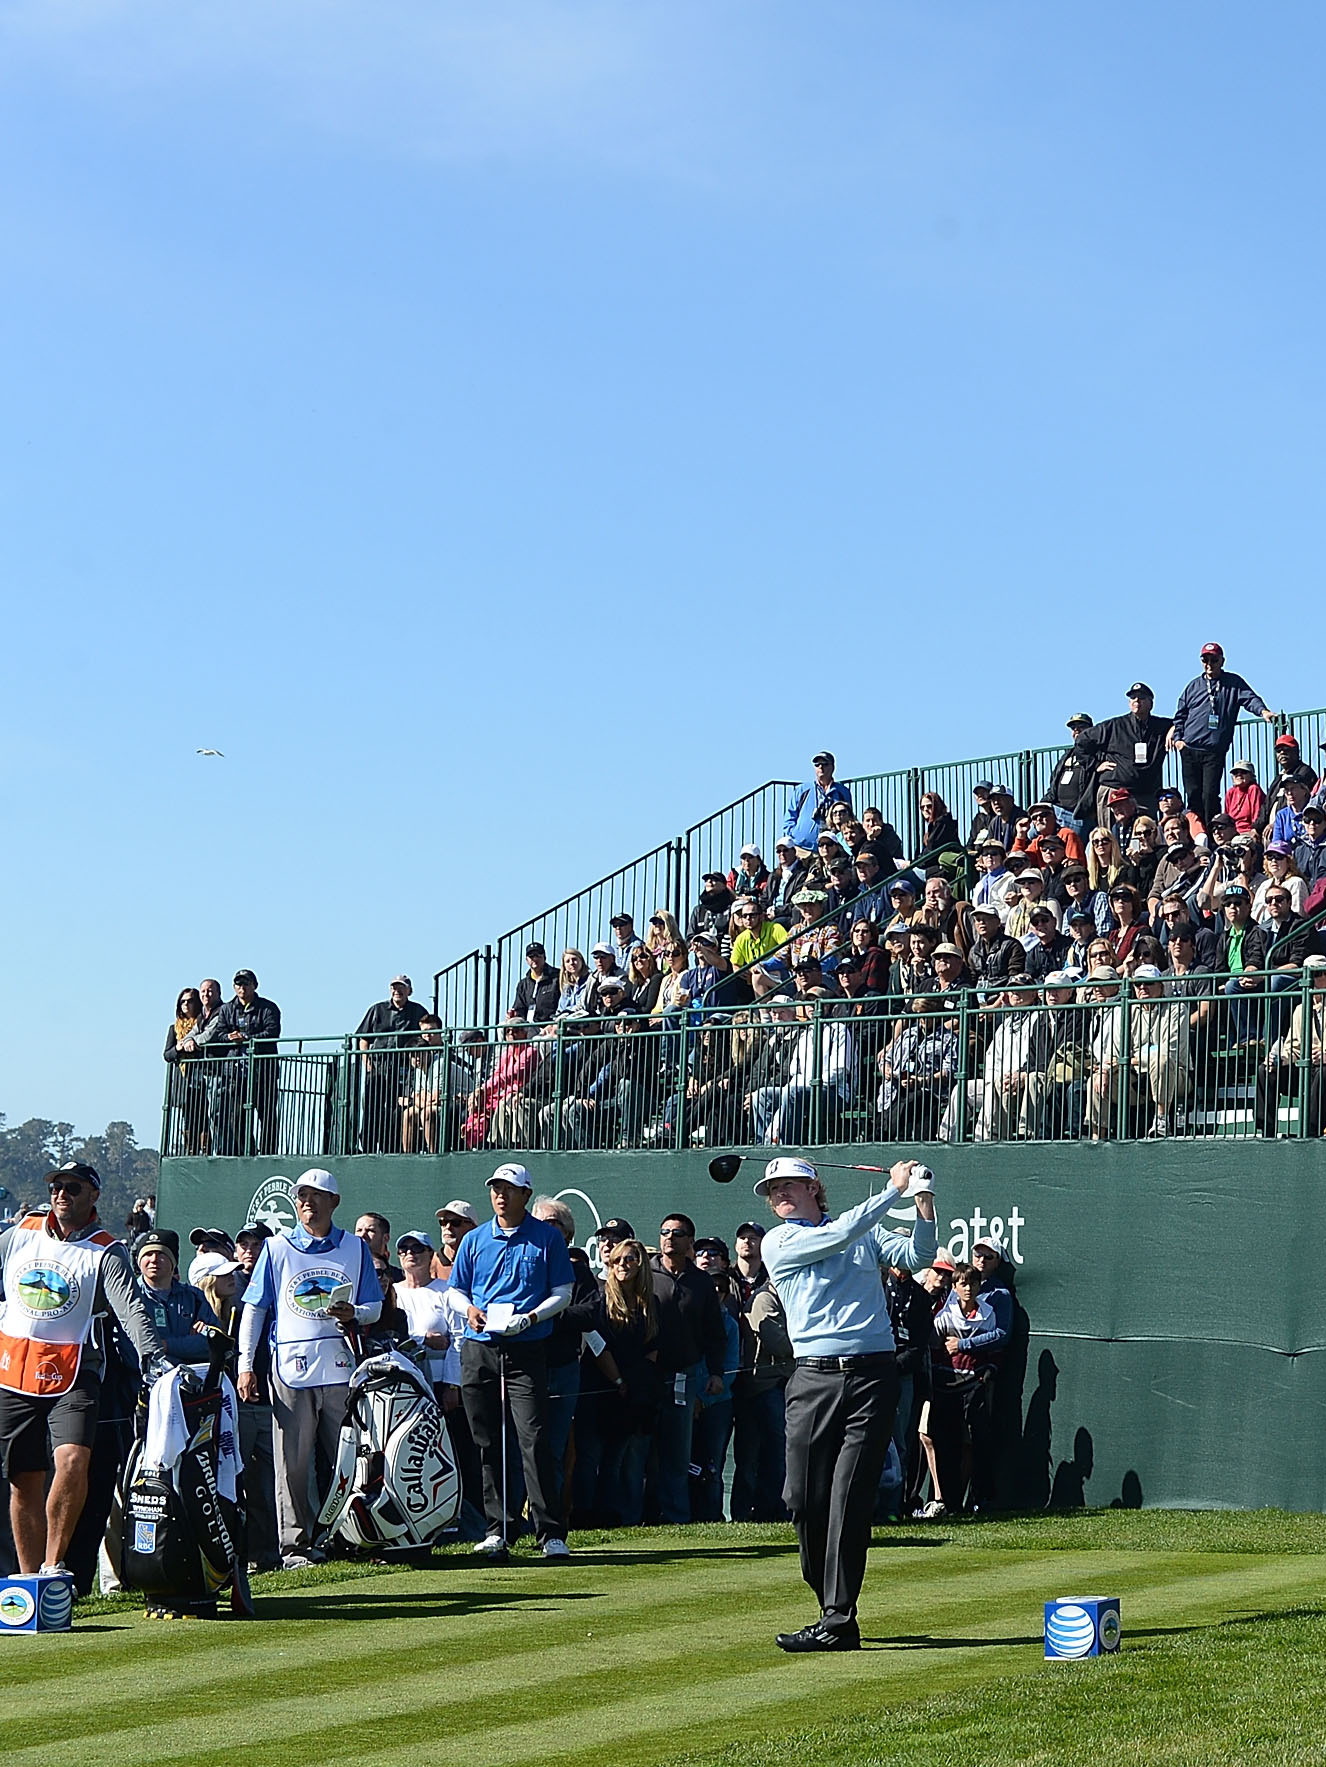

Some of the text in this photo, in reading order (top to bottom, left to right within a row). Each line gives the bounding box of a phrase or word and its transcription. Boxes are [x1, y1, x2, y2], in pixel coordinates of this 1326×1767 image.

[264, 1181, 288, 1196] PEBBLE
[948, 1206, 1025, 1264] at&t
[288, 1269, 349, 1293] AT&T PEBBLE BEAC
[41, 1300, 74, 1317] PRO-AM
[400, 1402, 445, 1514] Callaway
[129, 1491, 167, 1506] SNEDS
[195, 1485, 221, 1546] GOLF
[137, 1542, 153, 1550] RBC
